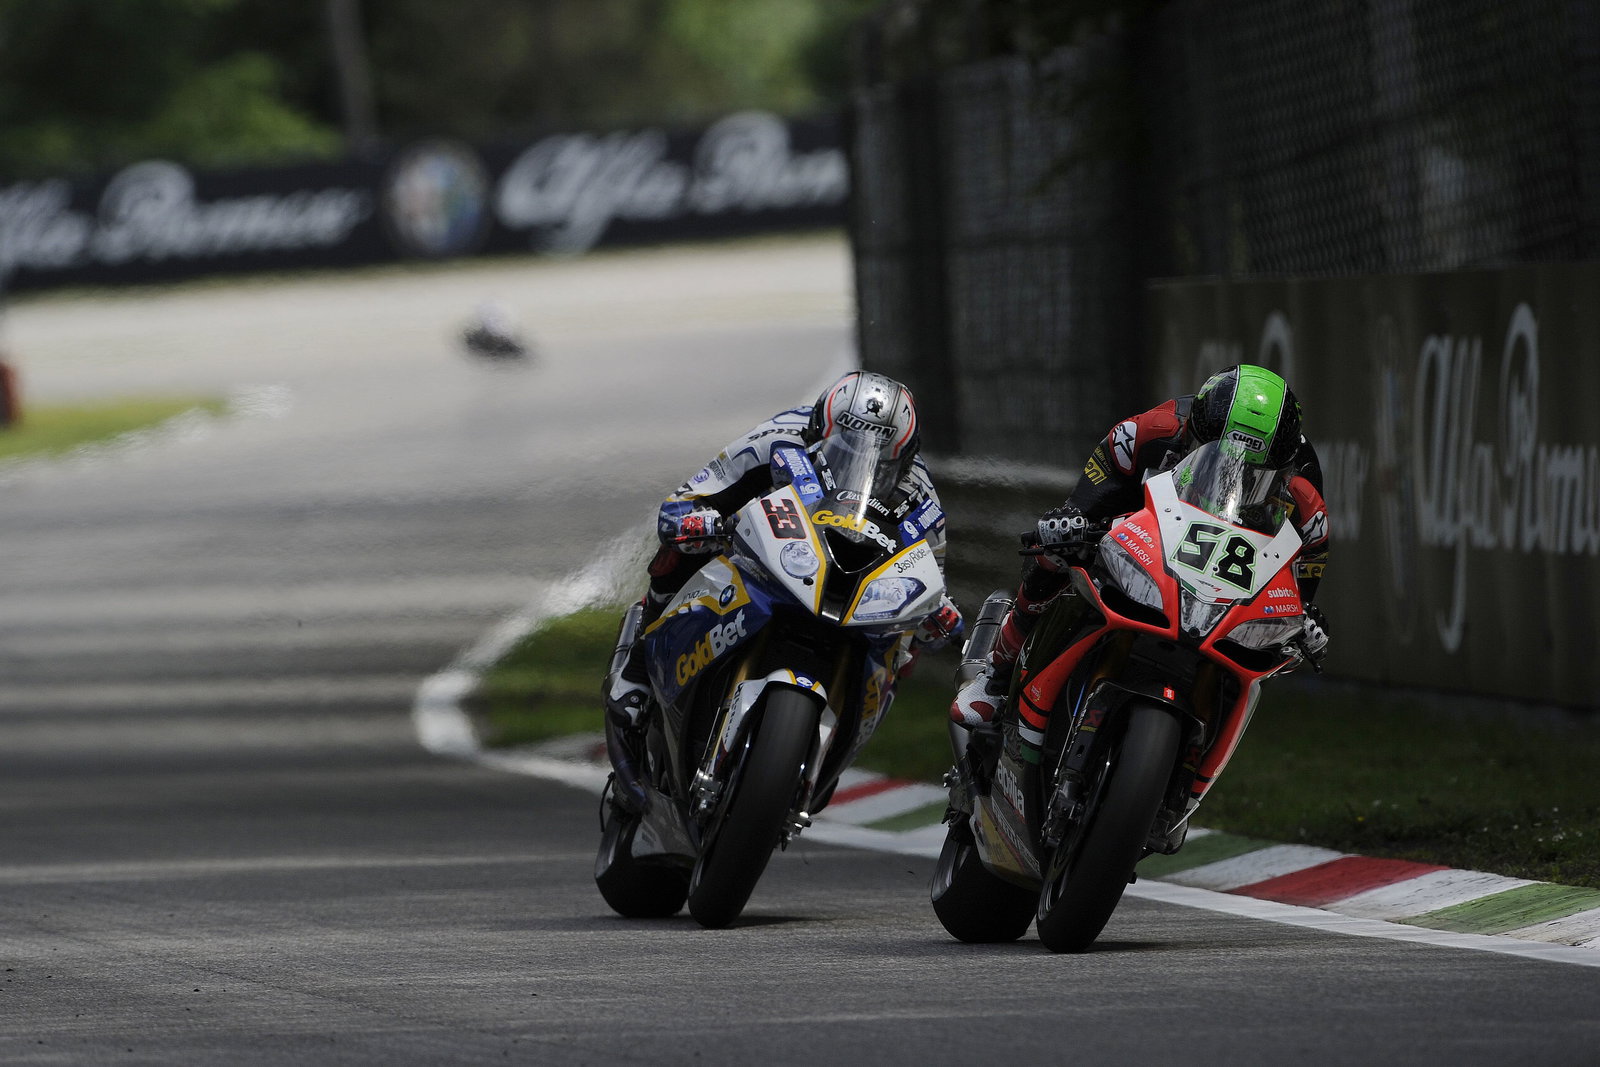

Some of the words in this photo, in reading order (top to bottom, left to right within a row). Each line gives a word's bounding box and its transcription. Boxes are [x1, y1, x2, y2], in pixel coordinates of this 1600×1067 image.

[760, 498, 807, 540] 33
[812, 510, 897, 554] GoldBet
[1125, 539, 1153, 566] MARSH
[1169, 520, 1258, 595] 58
[1275, 604, 1298, 613] MARSH
[676, 608, 747, 687] GoldBet
